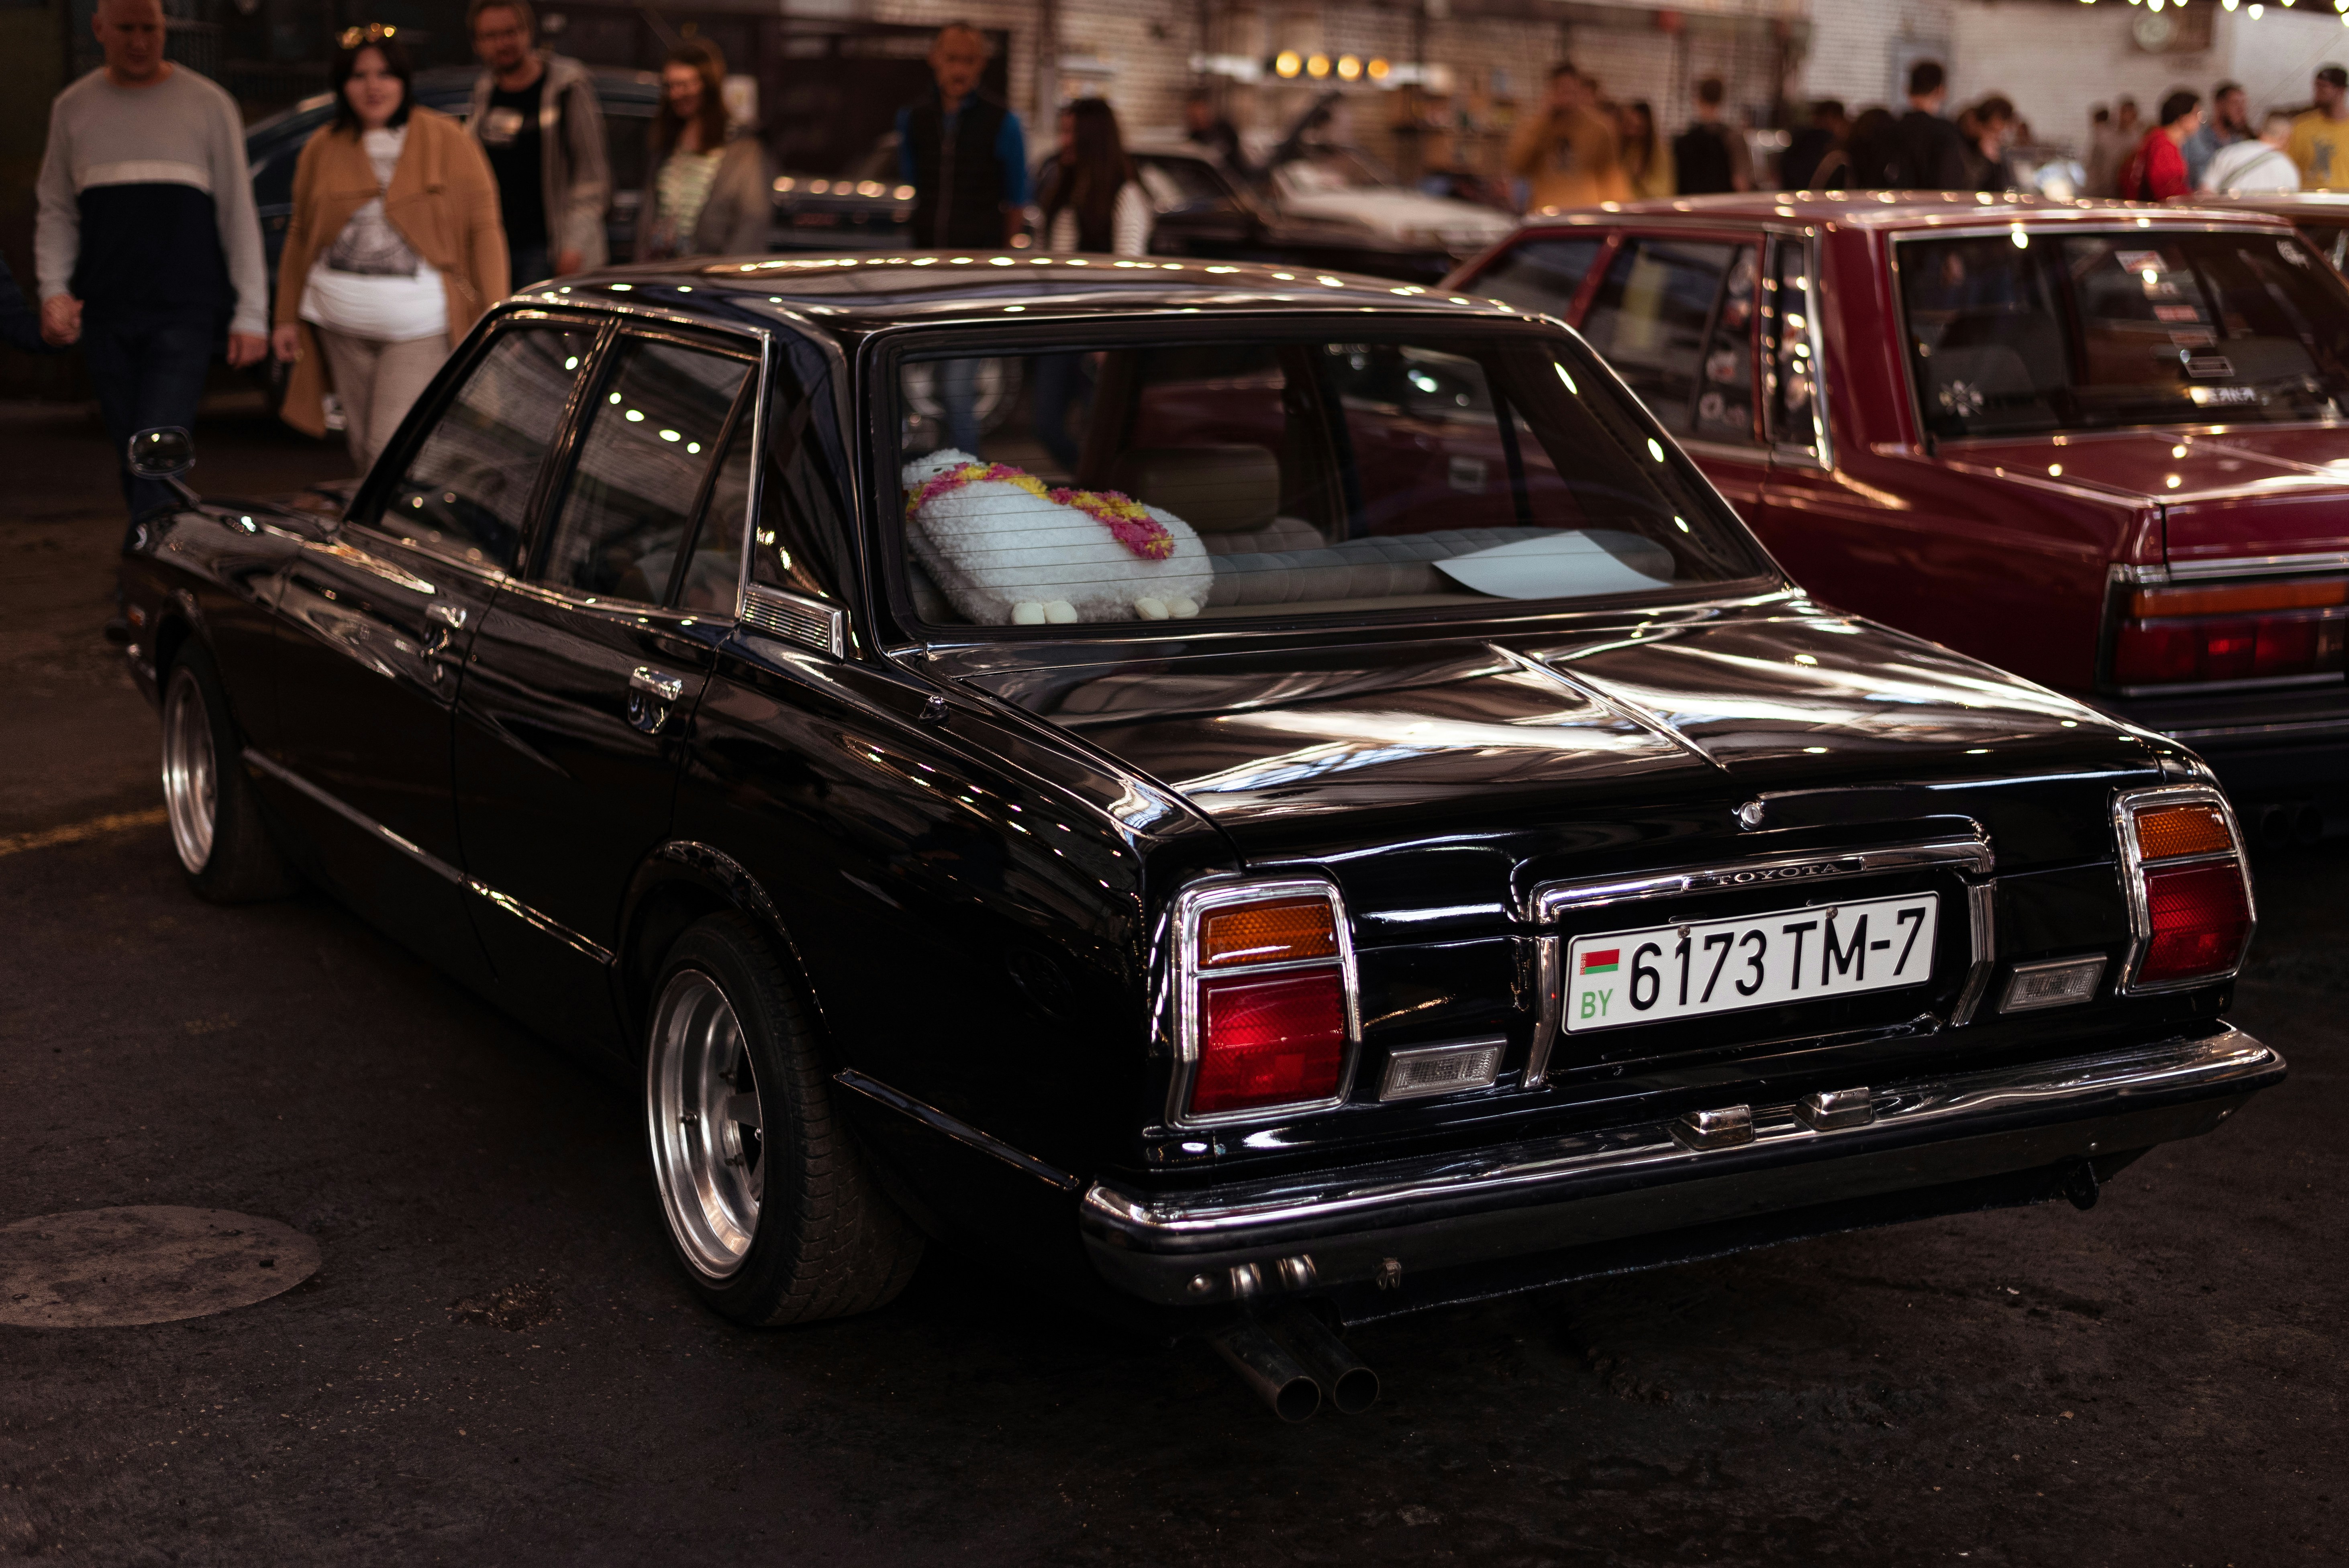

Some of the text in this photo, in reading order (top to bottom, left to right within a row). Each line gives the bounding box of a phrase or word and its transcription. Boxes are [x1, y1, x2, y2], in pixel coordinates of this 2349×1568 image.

[1712, 863, 1841, 885] TOYOTA
[1629, 907, 1925, 1011] 6173 TM-7
[1580, 988, 1613, 1019] BY
